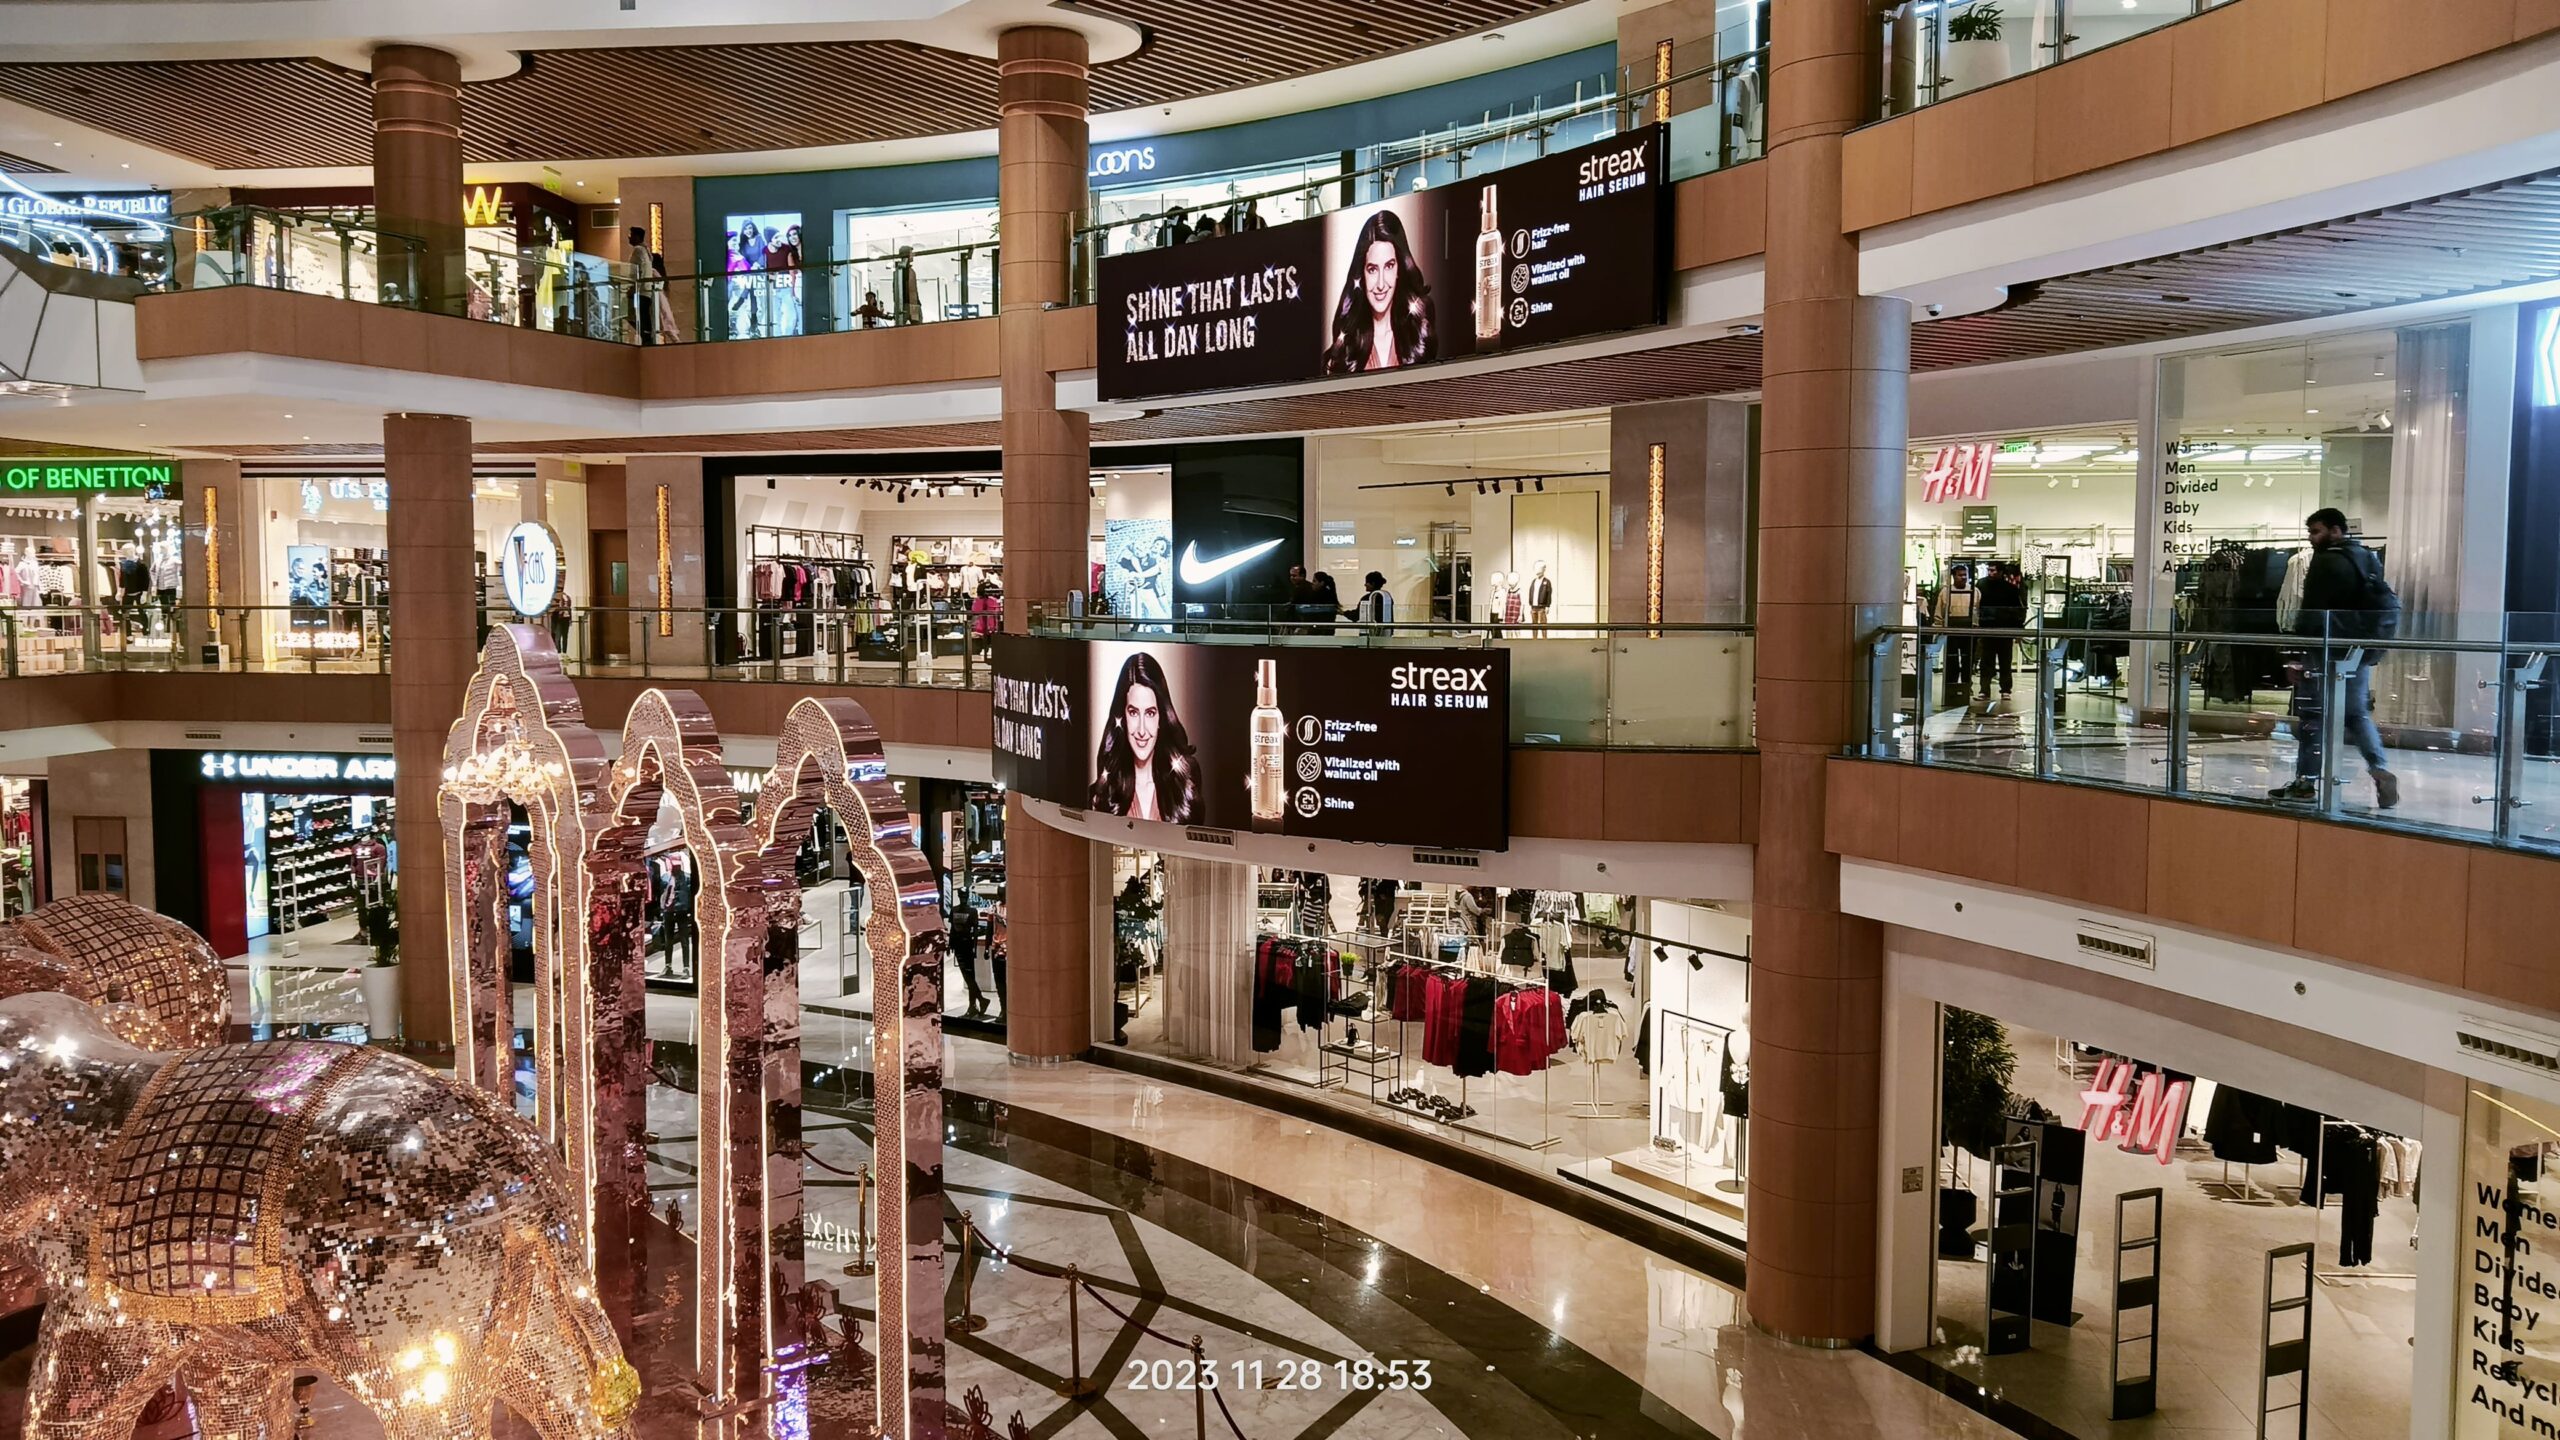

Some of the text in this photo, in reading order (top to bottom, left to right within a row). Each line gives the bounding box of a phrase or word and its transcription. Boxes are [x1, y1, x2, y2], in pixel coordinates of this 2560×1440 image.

[1579, 144, 1645, 185] streax
[1579, 171, 1646, 202] HAIR SERUM
[1532, 223, 1570, 239] Frizz-free
[1531, 239, 1548, 250] hair
[1531, 254, 1586, 275] Vitalized with
[1531, 269, 1570, 286] walnut oil
[1126, 265, 1298, 324] SHINE THAT LASTS
[1531, 302, 1553, 314] Shine
[1126, 315, 1255, 363] ALL DAY LONG
[2166, 441, 2218, 455] Women
[7, 466, 171, 489] OF BENETTON
[1921, 443, 1997, 504] H&M
[2165, 461, 2196, 475] Men
[2164, 478, 2218, 495] Divided
[2164, 501, 2200, 516] Baby
[1972, 532, 1994, 541] 2299
[2163, 520, 2193, 534] Kids
[2163, 538, 2217, 554] Recycle
[1391, 662, 1488, 691] streax
[1008, 678, 1029, 714] THAT
[1031, 682, 1069, 720] LASTS
[1391, 693, 1489, 709] HAIR SERUM
[1324, 720, 1378, 733] Frizz-free
[1015, 722, 1042, 761] LONG
[1324, 731, 1345, 742] hair
[239, 757, 338, 778] UNDER
[1324, 756, 1400, 771] Vitalized with
[1324, 770, 1378, 781] walnut oil
[1302, 793, 1314, 804] 24
[1324, 797, 1355, 810] Shine
[2080, 1058, 2191, 1165] H&M
[2477, 1182, 2560, 1231] Wome
[2476, 1216, 2531, 1256] Men
[2474, 1283, 2540, 1331] Baby
[2473, 1316, 2526, 1356] Kids
[2473, 1349, 2560, 1406] Recycl
[2471, 1384, 2560, 1440] And m
